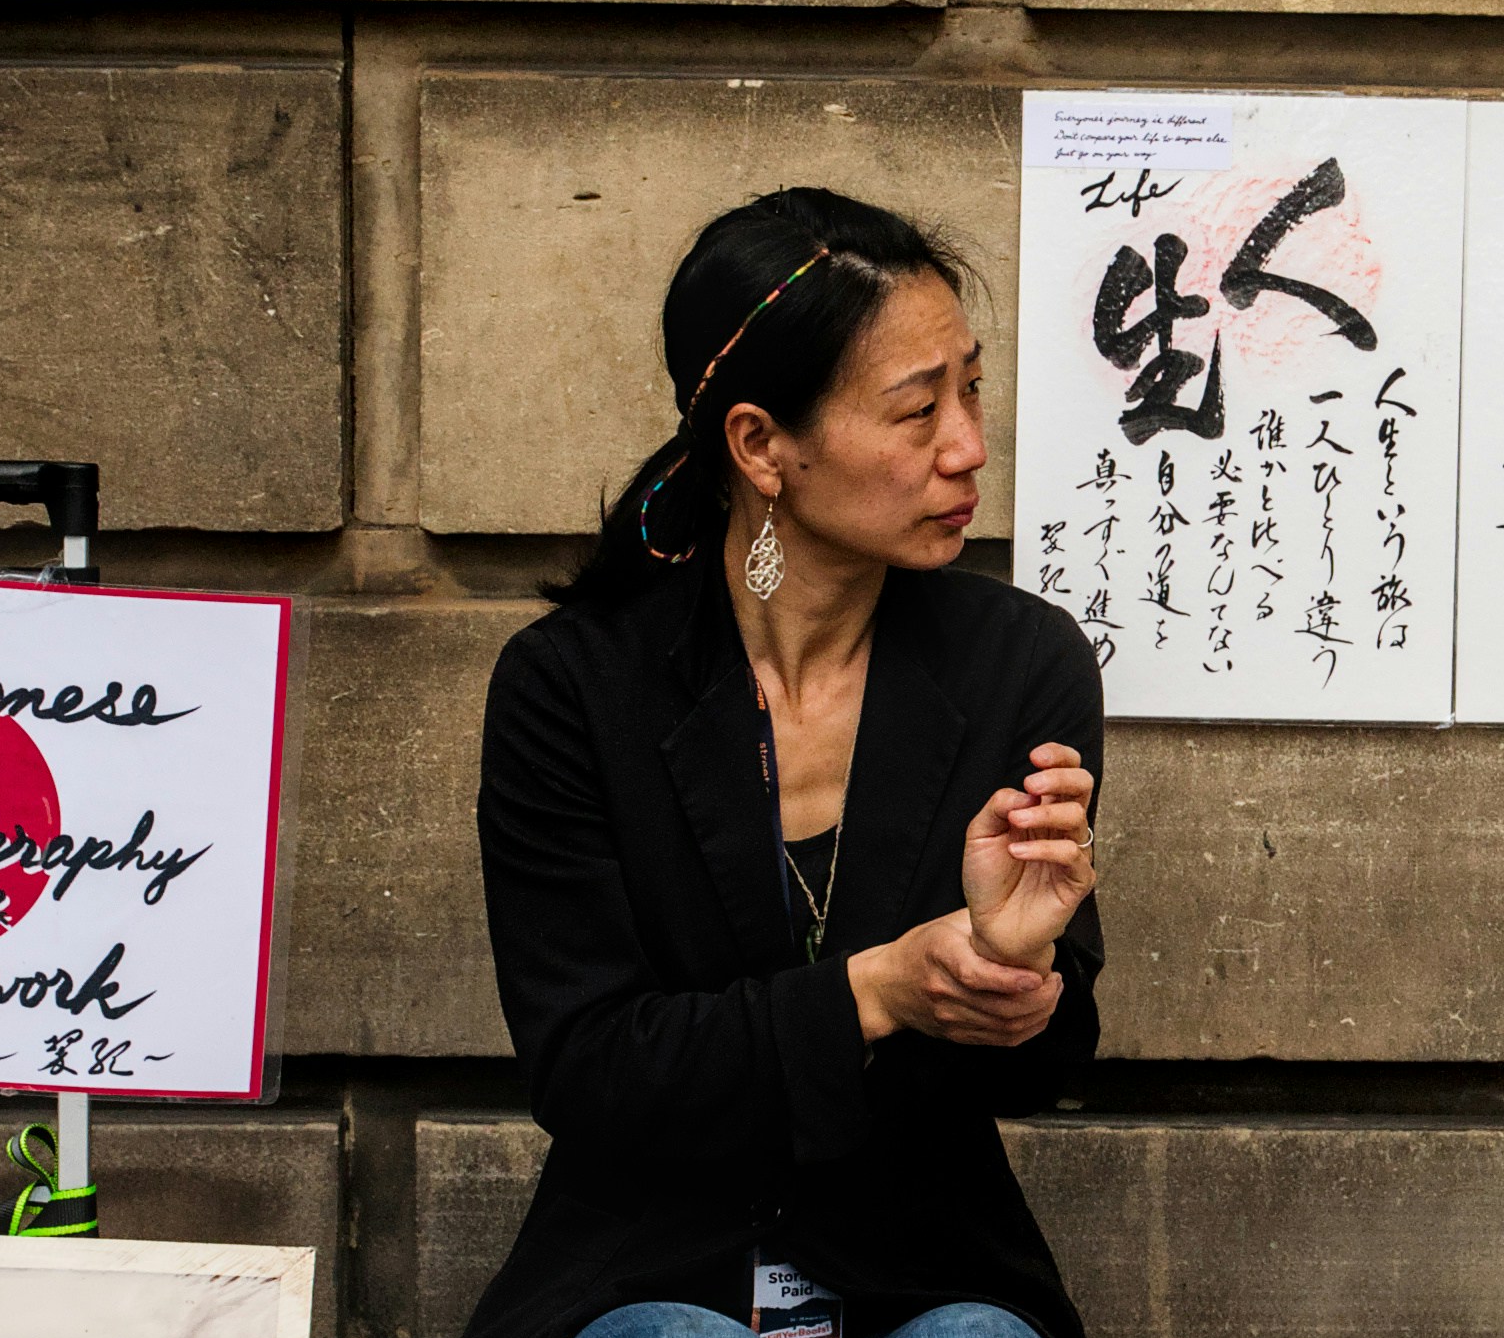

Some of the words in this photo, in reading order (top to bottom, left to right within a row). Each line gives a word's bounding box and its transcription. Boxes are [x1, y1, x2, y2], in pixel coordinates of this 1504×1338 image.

[1077, 150, 1089, 160] go
[1106, 151, 1129, 161] your
[1134, 151, 1157, 160] way
[1081, 168, 1186, 218] Life
[1371, 366, 1417, 652] 人生という旅は
[781, 1283, 814, 1298] Paid
